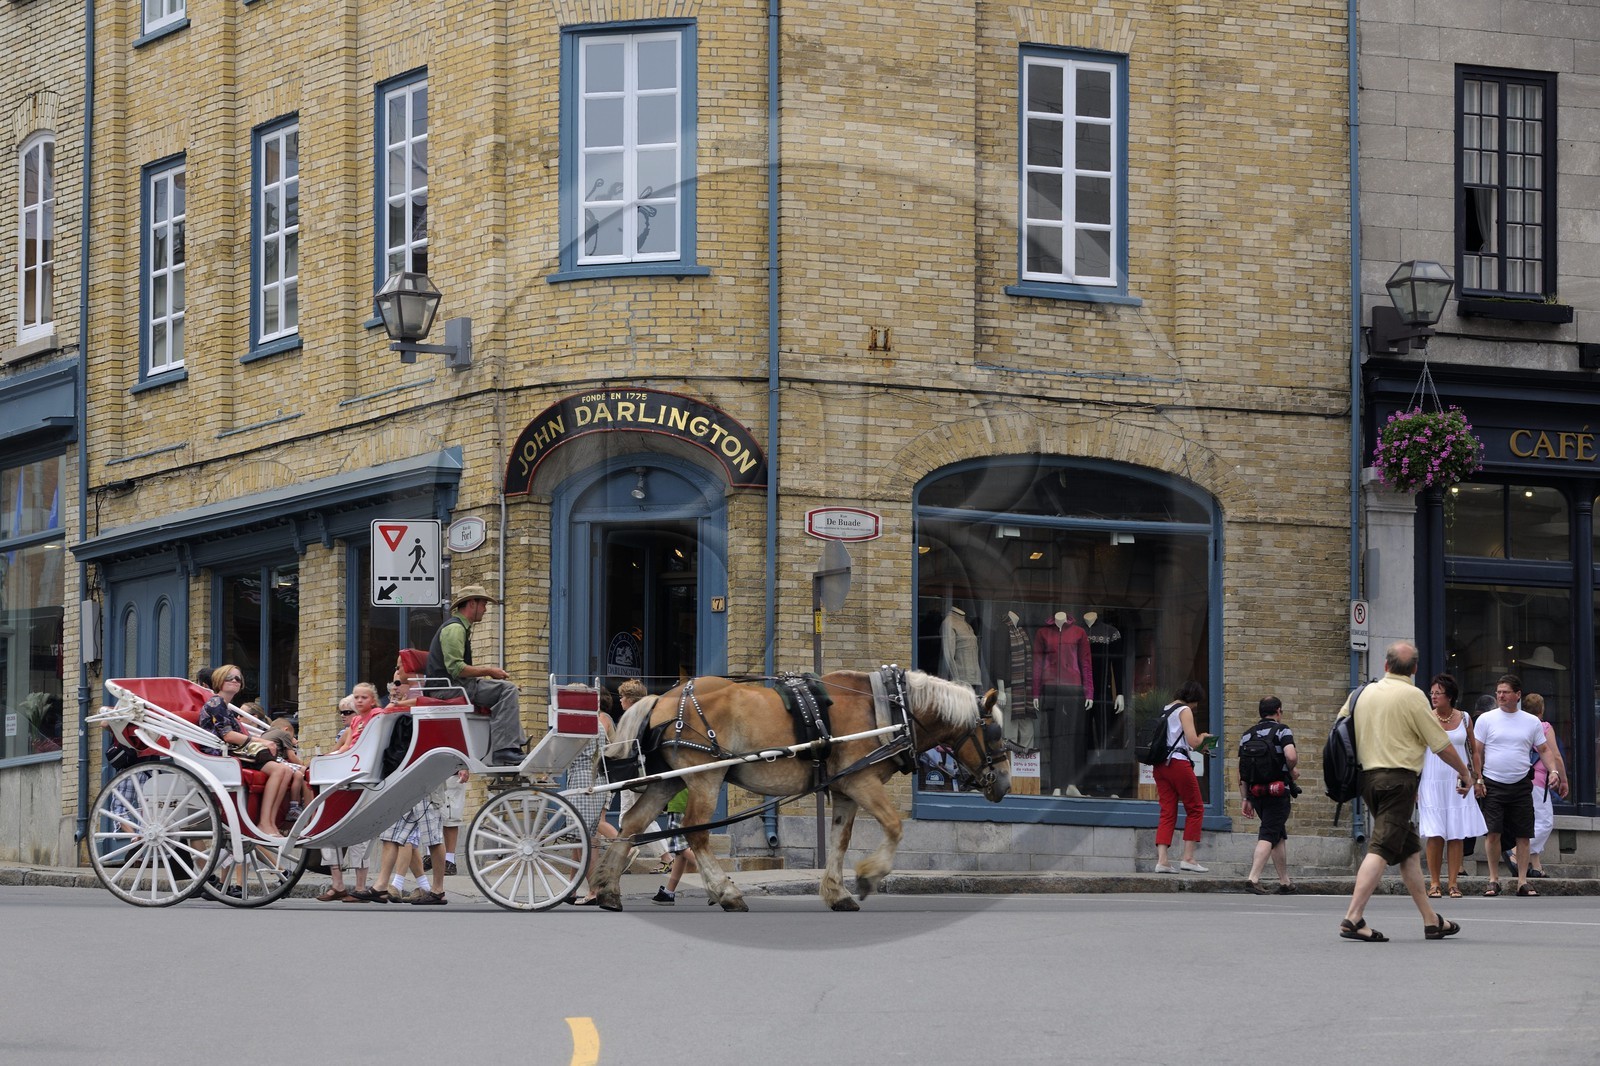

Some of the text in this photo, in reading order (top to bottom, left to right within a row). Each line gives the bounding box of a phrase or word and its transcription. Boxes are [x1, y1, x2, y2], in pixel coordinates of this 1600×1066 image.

[581, 392, 648, 403] FONDÉ EN 1775
[520, 401, 758, 477] JOHN DARLINGTON
[1509, 424, 1598, 461] CAFÉ
[826, 518, 861, 527] De Buade
[714, 598, 721, 610] 7
[608, 665, 641, 677] DARLINGTON
[351, 754, 361, 772] 2
